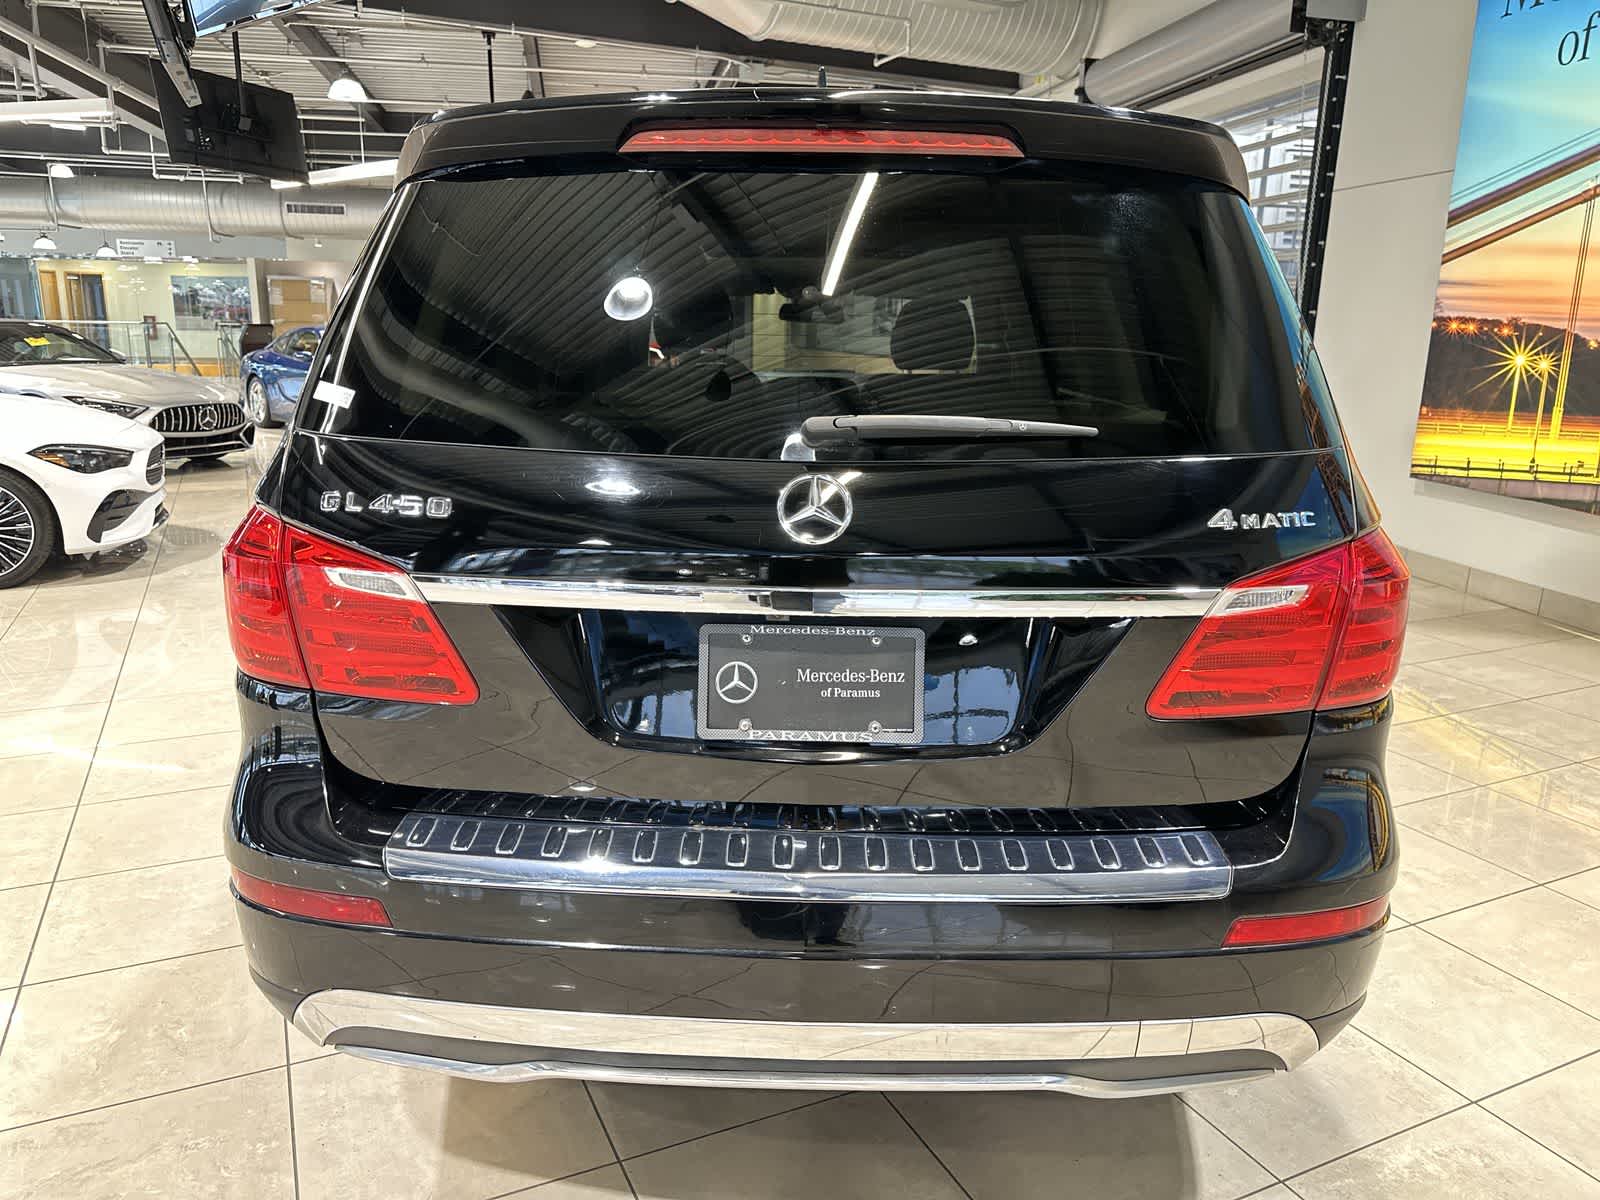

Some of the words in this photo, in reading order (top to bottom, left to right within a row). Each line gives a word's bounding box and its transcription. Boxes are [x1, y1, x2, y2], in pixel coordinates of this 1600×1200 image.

[1558, 10, 1600, 66] of
[750, 624, 877, 637] Mercedes-Benz
[796, 668, 905, 684] Mercedes-Benz
[820, 688, 833, 698] of
[834, 688, 881, 699] Paramus
[748, 730, 874, 743] PARAMUS
